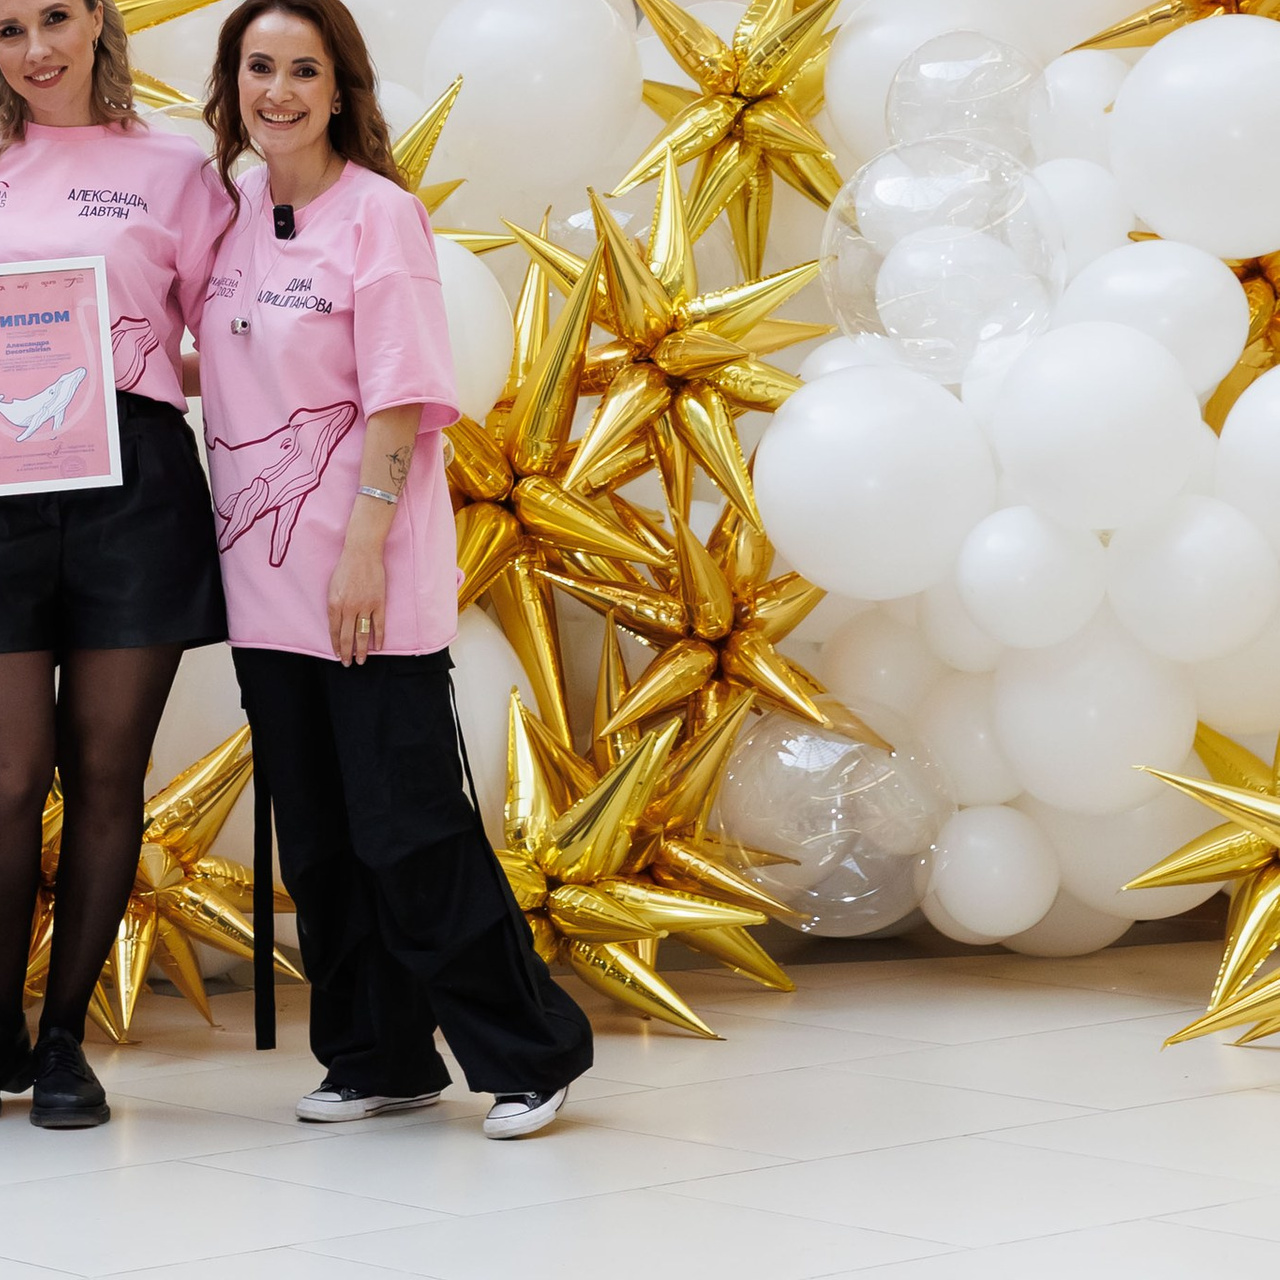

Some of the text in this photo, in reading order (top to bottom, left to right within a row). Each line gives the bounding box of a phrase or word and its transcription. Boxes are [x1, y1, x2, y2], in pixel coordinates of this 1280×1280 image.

[67, 188, 149, 214] АЛЕКСАНДРА
[78, 205, 130, 220] ДАВТЯН
[217, 286, 236, 298] 2025
[285, 278, 313, 292] ДИНА
